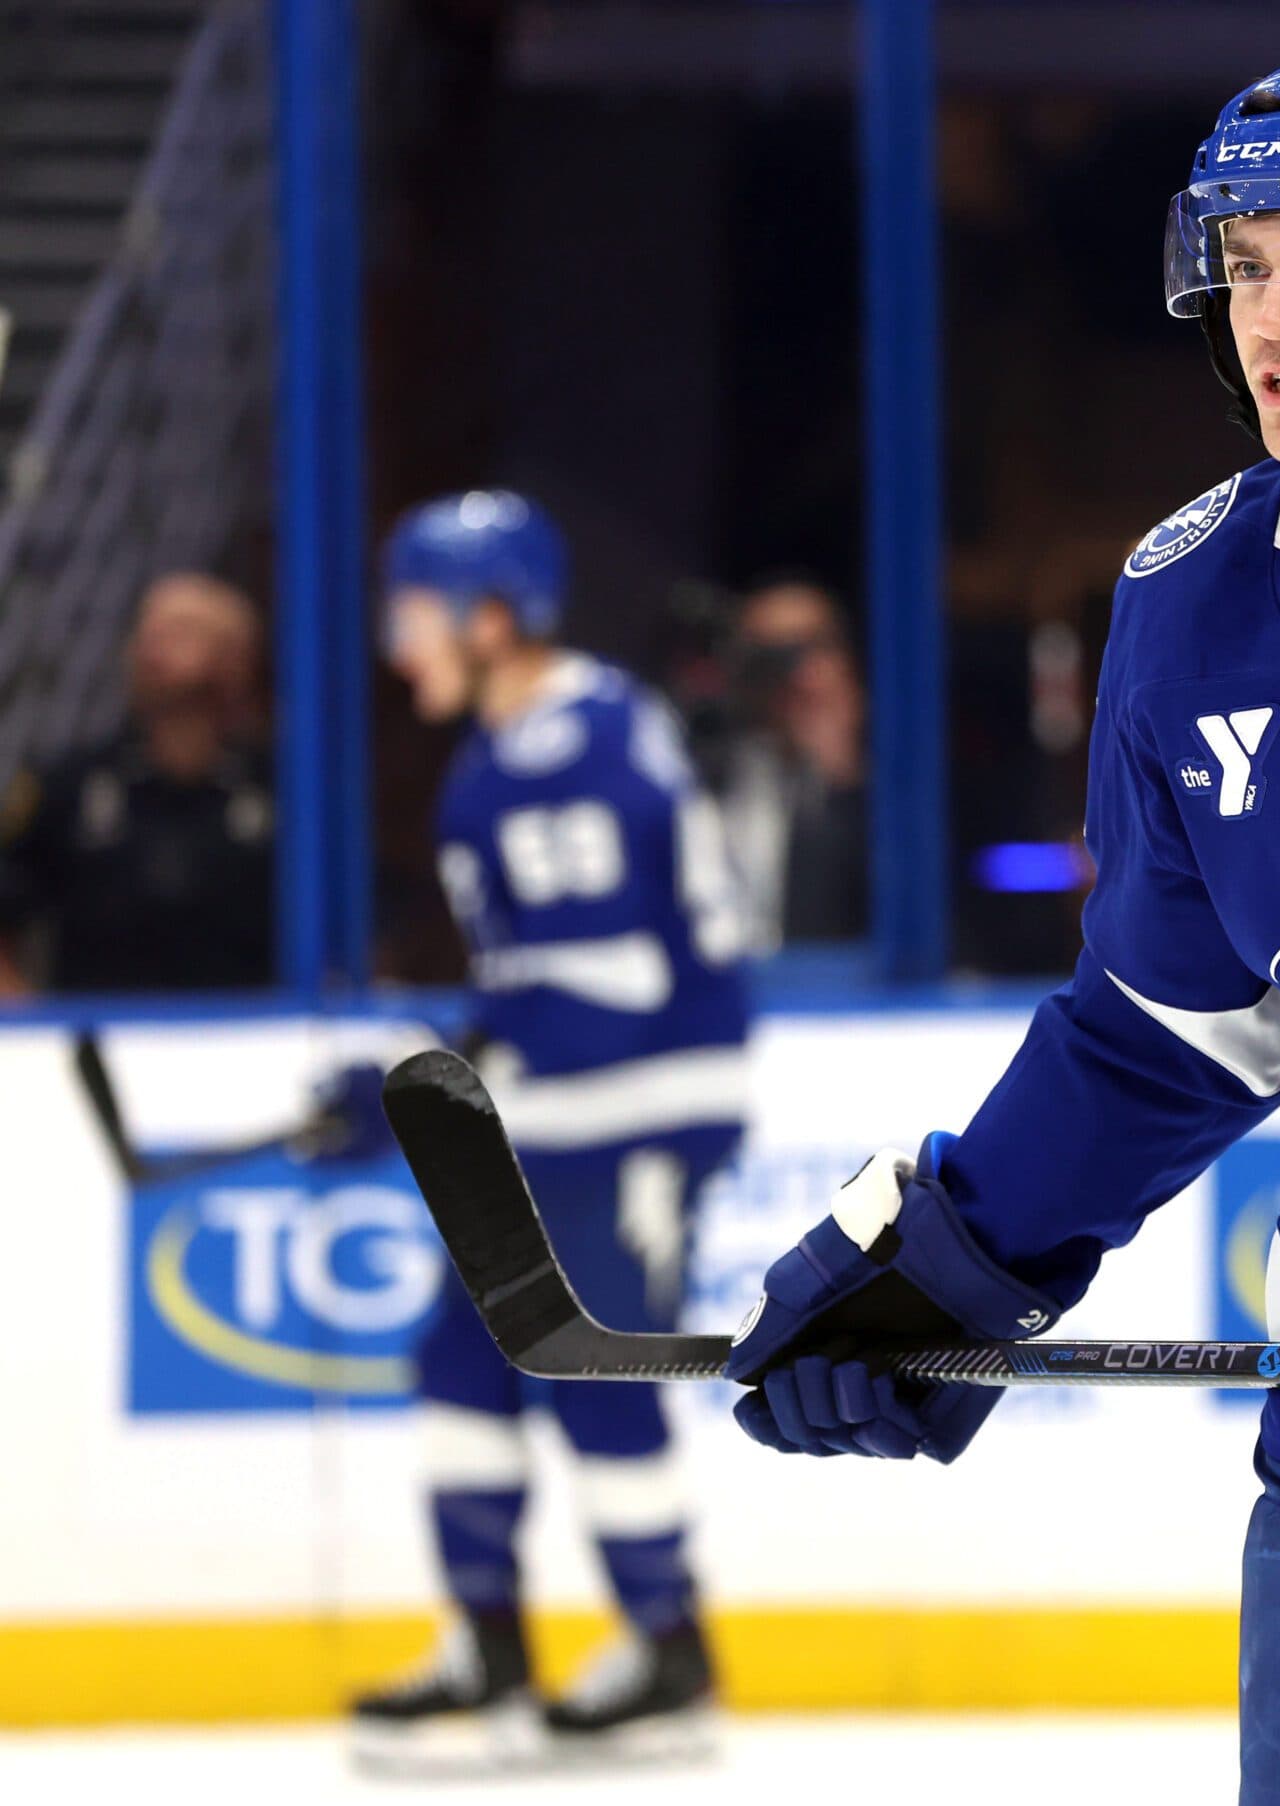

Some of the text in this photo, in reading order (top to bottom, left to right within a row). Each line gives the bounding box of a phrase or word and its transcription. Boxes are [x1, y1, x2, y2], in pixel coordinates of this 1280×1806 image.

[1139, 502, 1225, 568] LIGHTNING
[1181, 707, 1273, 816] the Y
[1244, 785, 1257, 811] YMCA
[1074, 1351, 1101, 1361] PRO
[1103, 1344, 1246, 1369] COVERT
